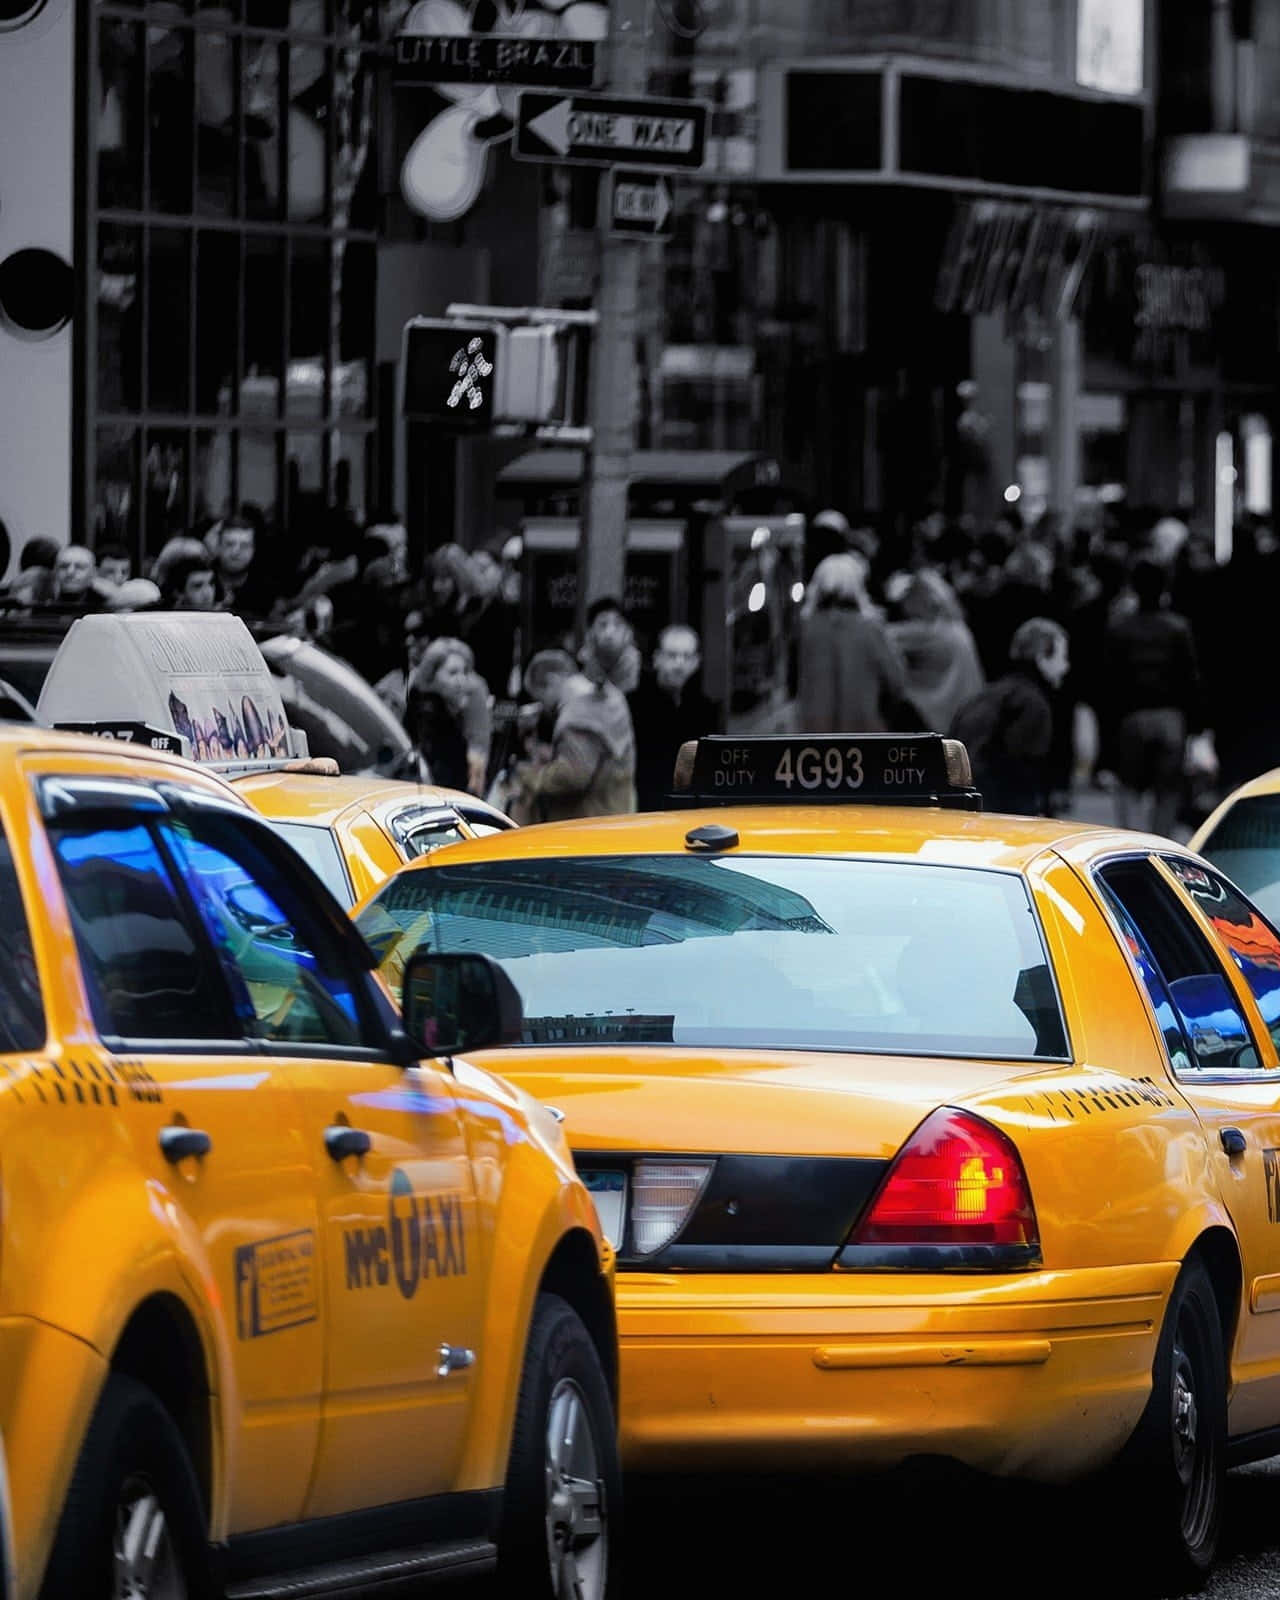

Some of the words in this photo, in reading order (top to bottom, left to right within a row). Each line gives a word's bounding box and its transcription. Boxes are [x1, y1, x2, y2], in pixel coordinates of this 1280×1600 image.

[397, 38, 480, 67] LITTLE
[496, 42, 594, 69] BRAZIL
[567, 113, 616, 145] ONE
[633, 118, 690, 149] WAY
[151, 737, 169, 749] OFF
[720, 749, 750, 765] OFF
[888, 748, 918, 763] OFF
[775, 748, 864, 789] 4G93
[883, 768, 925, 785] DUTY
[714, 770, 755, 786] DUTY
[344, 1226, 389, 1290] NYC
[391, 1188, 467, 1286] TAXI
